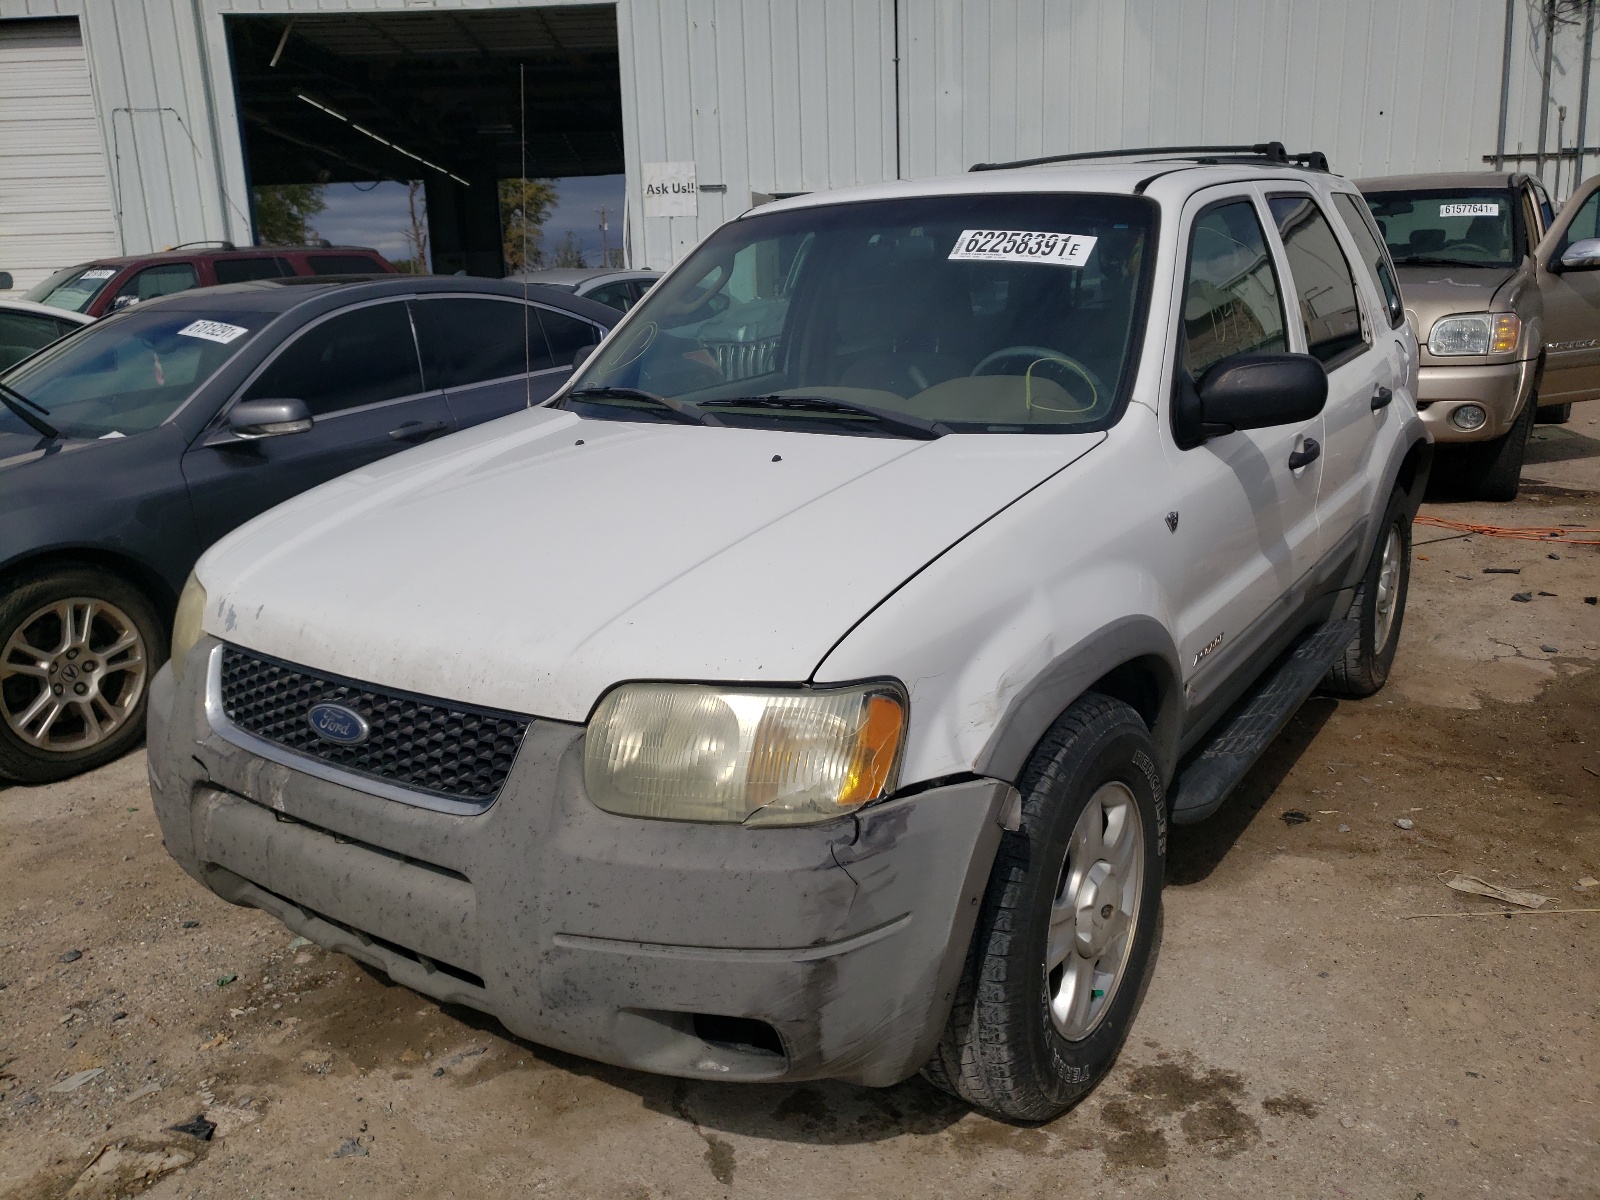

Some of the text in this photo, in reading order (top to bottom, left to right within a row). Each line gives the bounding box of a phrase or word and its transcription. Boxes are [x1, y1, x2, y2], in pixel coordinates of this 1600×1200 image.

[646, 182, 695, 194] Ask Us!!
[320, 709, 352, 736] Ford
[1132, 750, 1167, 857] HERCULES
